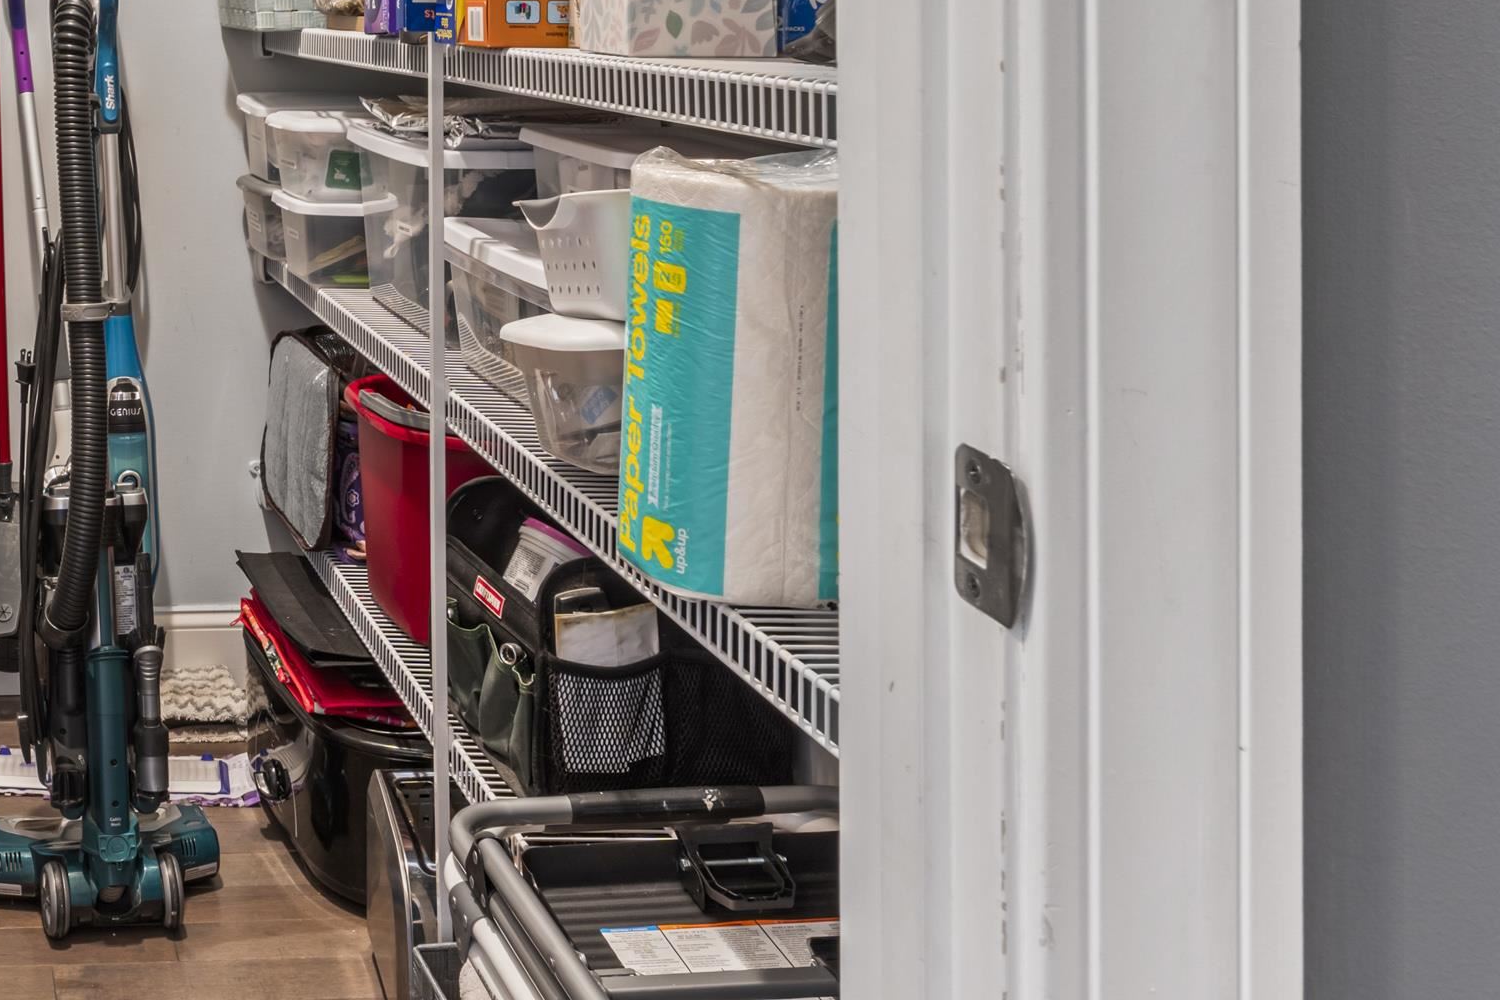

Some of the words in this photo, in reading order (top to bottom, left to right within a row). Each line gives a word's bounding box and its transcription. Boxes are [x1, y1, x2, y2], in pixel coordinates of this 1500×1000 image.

[105, 74, 115, 110] Shark
[626, 214, 652, 385] Towels
[110, 406, 141, 418] GENIUS
[619, 396, 644, 552] Paper
[676, 528, 690, 575] up&up
